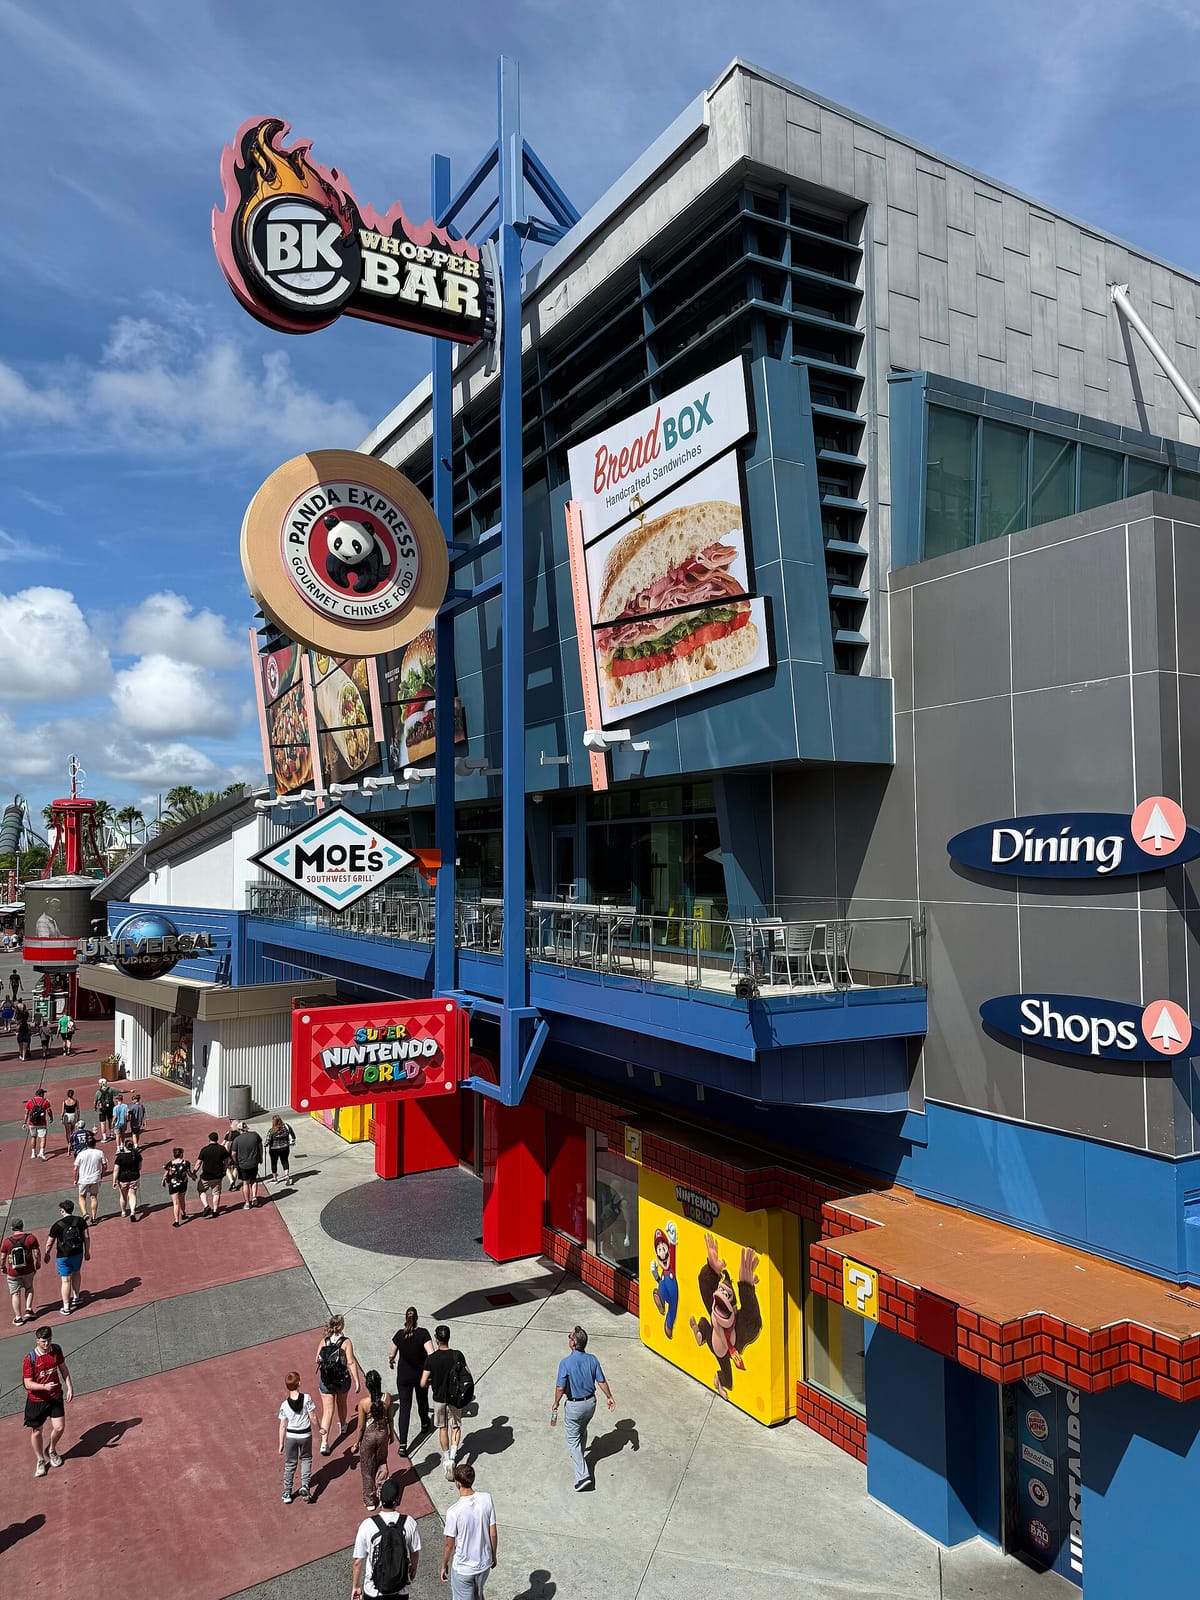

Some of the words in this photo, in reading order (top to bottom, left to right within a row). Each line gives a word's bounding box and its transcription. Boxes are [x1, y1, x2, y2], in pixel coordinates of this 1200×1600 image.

[266, 222, 343, 272] BK
[358, 228, 480, 278] WHOPPER
[360, 249, 481, 319] BAR
[605, 473, 651, 509] Handcrafted
[652, 444, 702, 481] Sandwiches
[288, 488, 342, 546] PANDA
[348, 487, 416, 559] EXPRESS
[291, 556, 340, 610] GOURMET
[342, 598, 393, 617] CHINESE
[392, 570, 414, 603] FOOD
[991, 826, 1126, 874] Dining
[306, 874, 351, 883] SOUTHWEST
[352, 874, 373, 882] GRILL
[354, 1023, 407, 1043] SUPER
[1020, 999, 1138, 1056] Shops
[321, 1037, 438, 1069] NINTENDO
[339, 1060, 420, 1085] WORLD
[675, 1186, 719, 1217] NINTENDO
